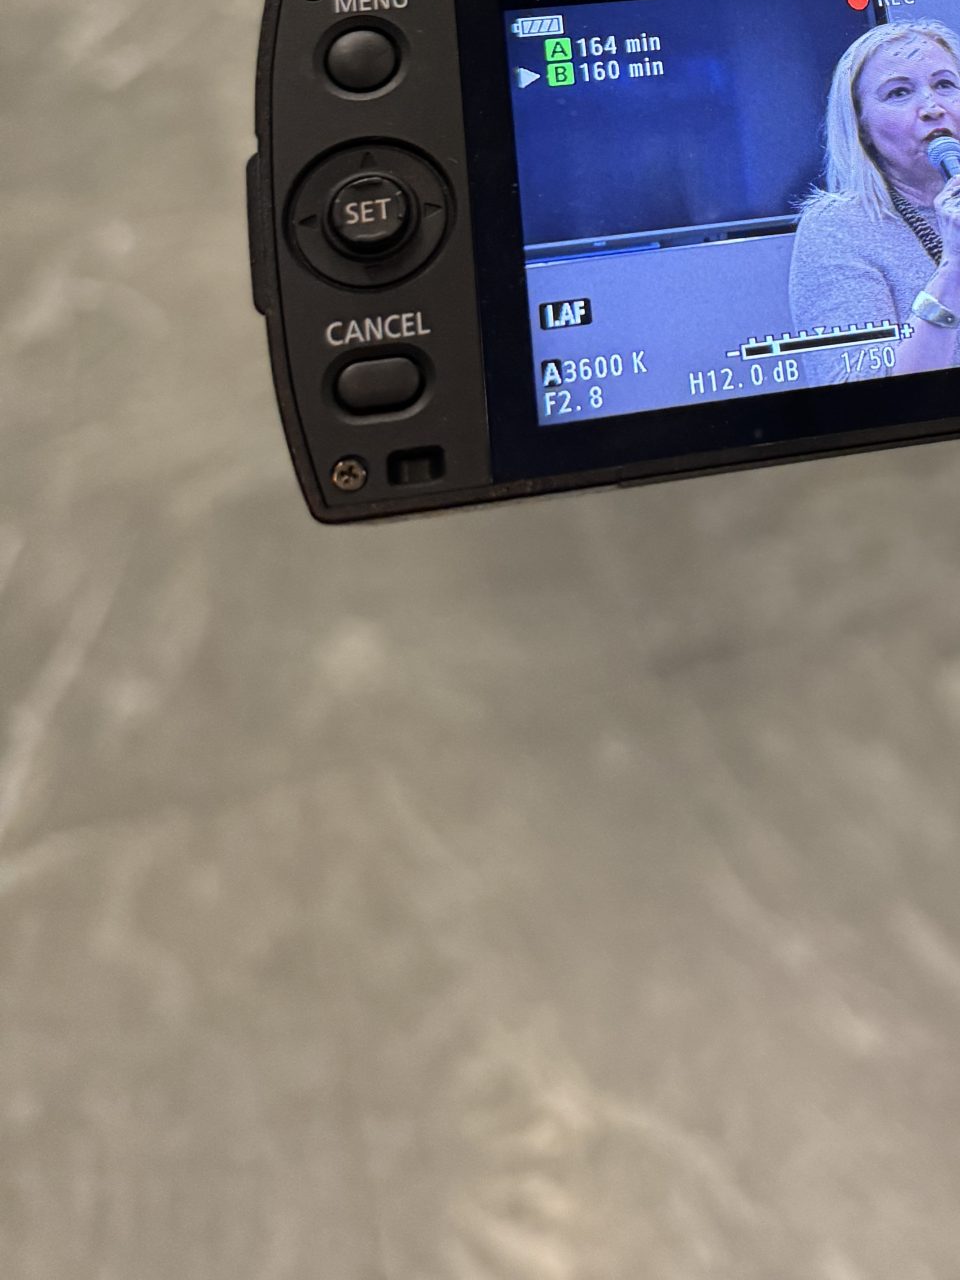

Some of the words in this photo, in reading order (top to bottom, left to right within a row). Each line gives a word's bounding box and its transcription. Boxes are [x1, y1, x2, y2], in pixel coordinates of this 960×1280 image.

[548, 39, 570, 60] A
[576, 35, 617, 57] 164
[625, 33, 661, 53] min
[552, 64, 571, 84] B
[579, 60, 620, 82] 160
[629, 58, 664, 78] min
[344, 198, 392, 224] SET
[326, 312, 430, 346] CANCEL
[632, 350, 647, 374] K
[773, 359, 799, 383] dB
[840, 346, 896, 373] 1/50
